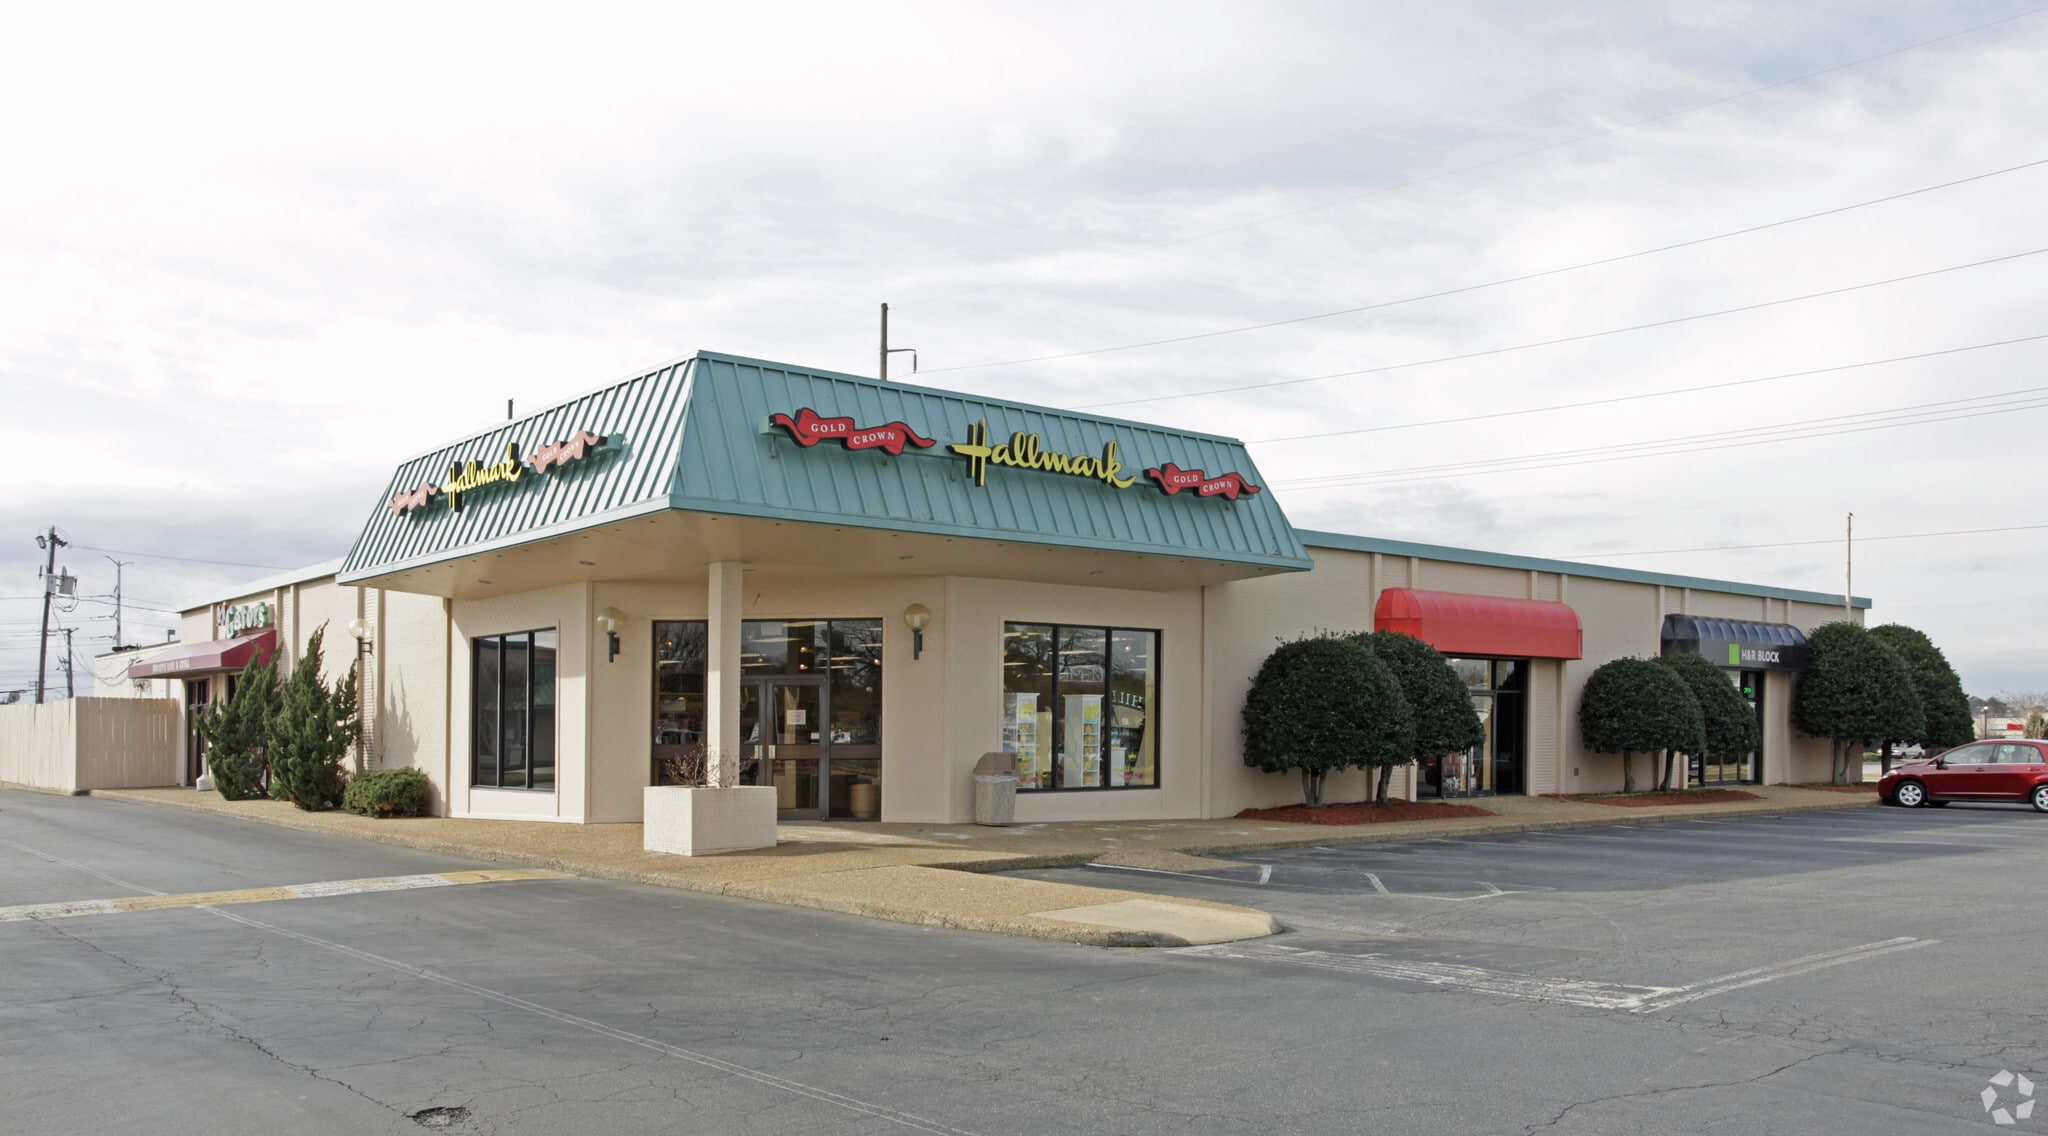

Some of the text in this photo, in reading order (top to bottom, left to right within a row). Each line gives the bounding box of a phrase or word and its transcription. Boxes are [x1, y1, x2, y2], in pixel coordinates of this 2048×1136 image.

[810, 423, 895, 444] GOLD CROWN
[949, 416, 1137, 490] Hallmark
[440, 441, 523, 513] Hallmark
[1173, 474, 1233, 493] GOLD CROWN
[1741, 649, 1780, 663] H&R BLOCK
